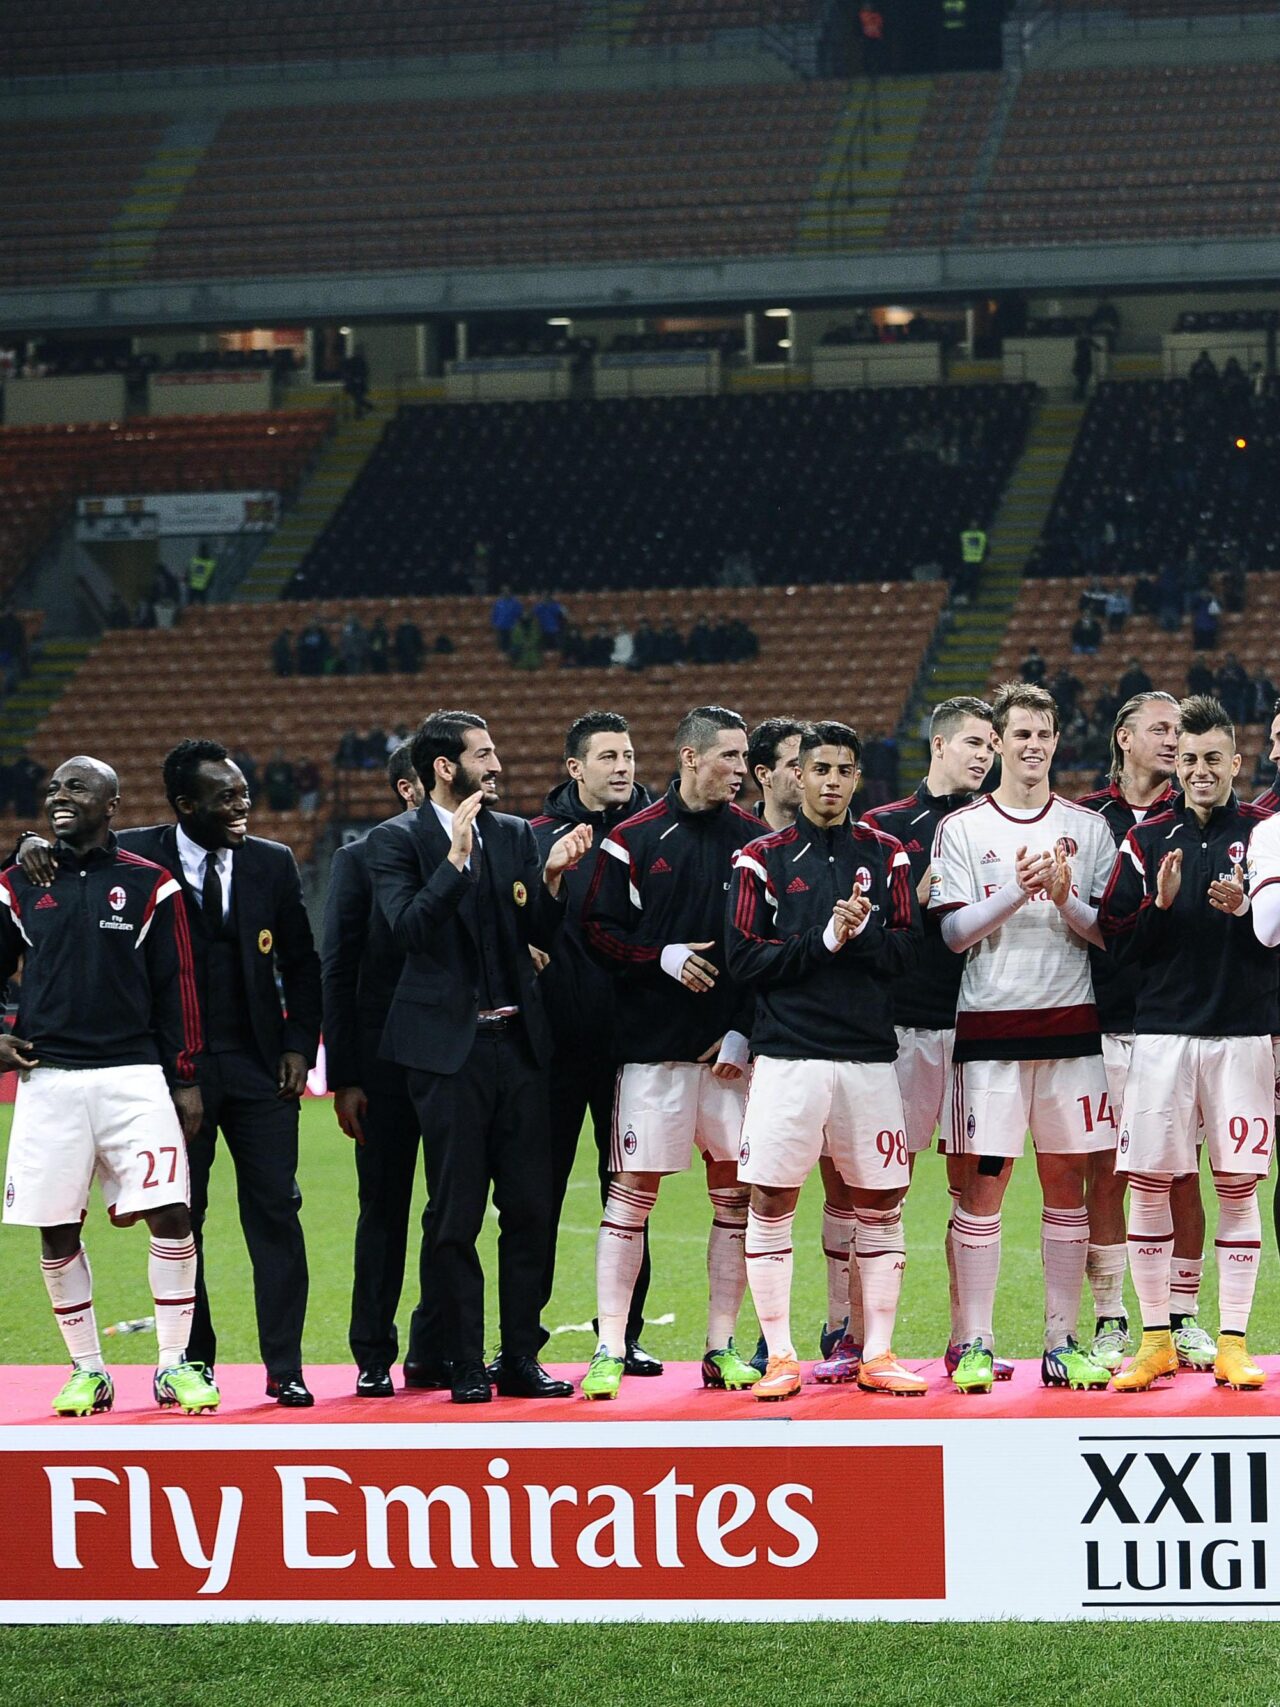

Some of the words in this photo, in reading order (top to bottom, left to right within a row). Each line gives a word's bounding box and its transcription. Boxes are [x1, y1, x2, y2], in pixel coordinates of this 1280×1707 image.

[1077, 1092, 1118, 1133] 14
[875, 1129, 908, 1169] 98
[1228, 1116, 1269, 1156] 92
[136, 1146, 177, 1189] 27
[1137, 1246, 1163, 1256] ACM
[1228, 1253, 1253, 1263] ACM
[61, 1316, 85, 1327] ACM
[42, 1465, 243, 1594] Fly
[273, 1457, 819, 1569] Emirates
[1085, 1539, 1267, 1592] LUIGI
